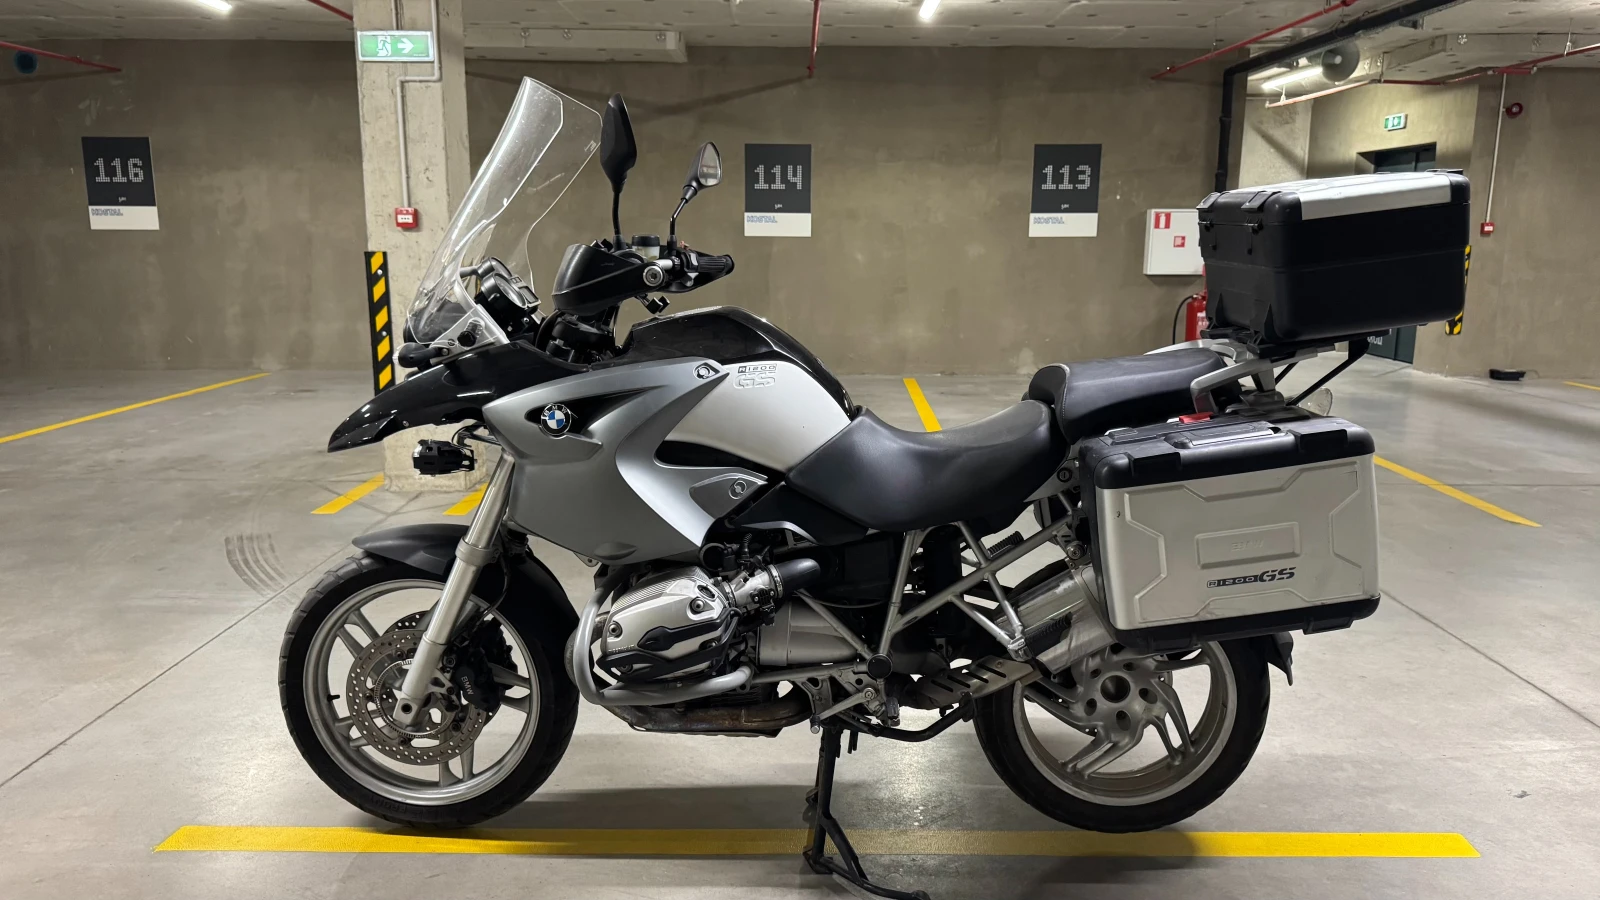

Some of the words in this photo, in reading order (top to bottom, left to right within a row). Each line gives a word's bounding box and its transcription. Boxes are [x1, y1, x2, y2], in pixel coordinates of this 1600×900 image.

[94, 158, 144, 183] 116
[754, 165, 802, 190] 114
[1041, 165, 1091, 190] 113
[746, 215, 778, 224] KOSTAL
[738, 364, 777, 373] R1200
[733, 372, 776, 389] GS
[461, 676, 474, 695] BMW
